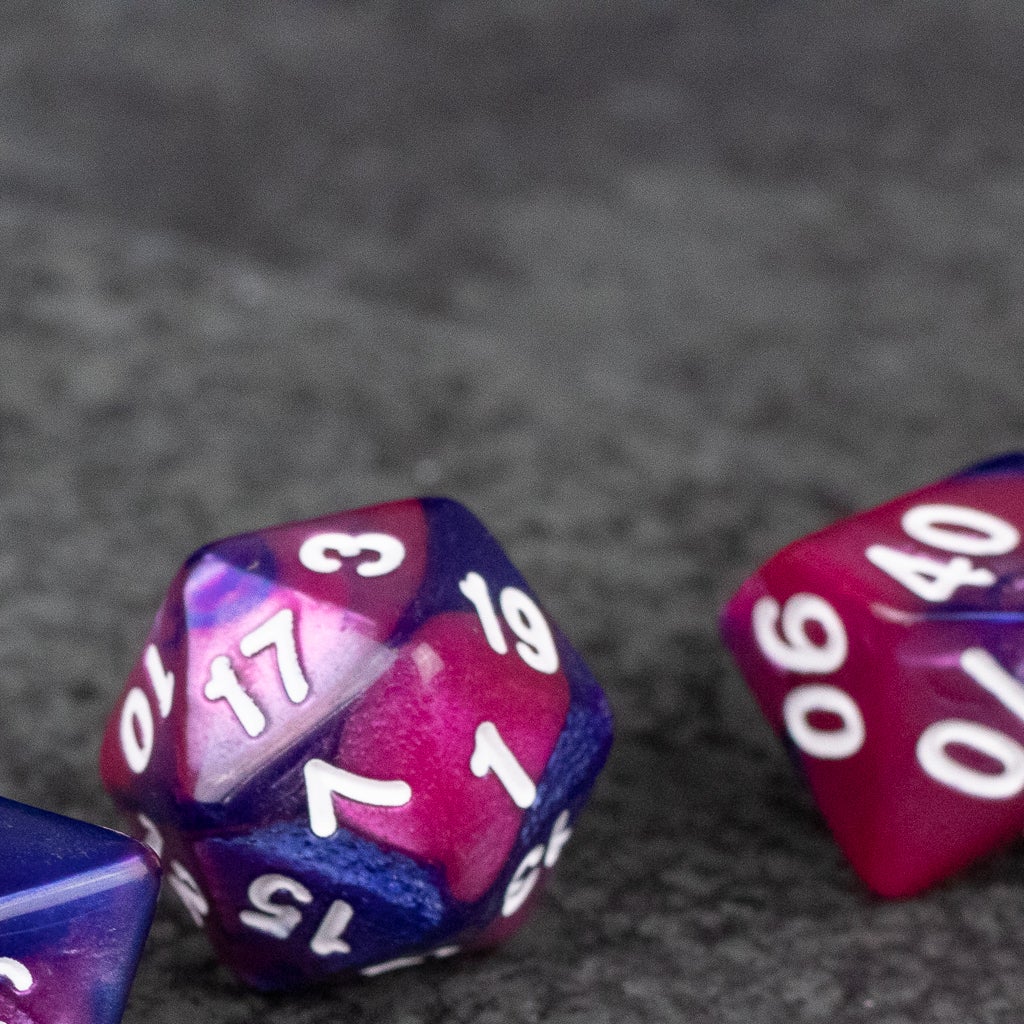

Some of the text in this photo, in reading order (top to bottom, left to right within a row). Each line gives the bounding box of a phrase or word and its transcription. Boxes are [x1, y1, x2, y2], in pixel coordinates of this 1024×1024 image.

[298, 531, 407, 578] 3
[864, 502, 1021, 603] 40
[459, 571, 559, 675] 19
[119, 643, 175, 774] 10
[204, 608, 310, 738] 17
[303, 758, 413, 838] 7
[470, 721, 537, 809] 1
[239, 873, 355, 957] 15
